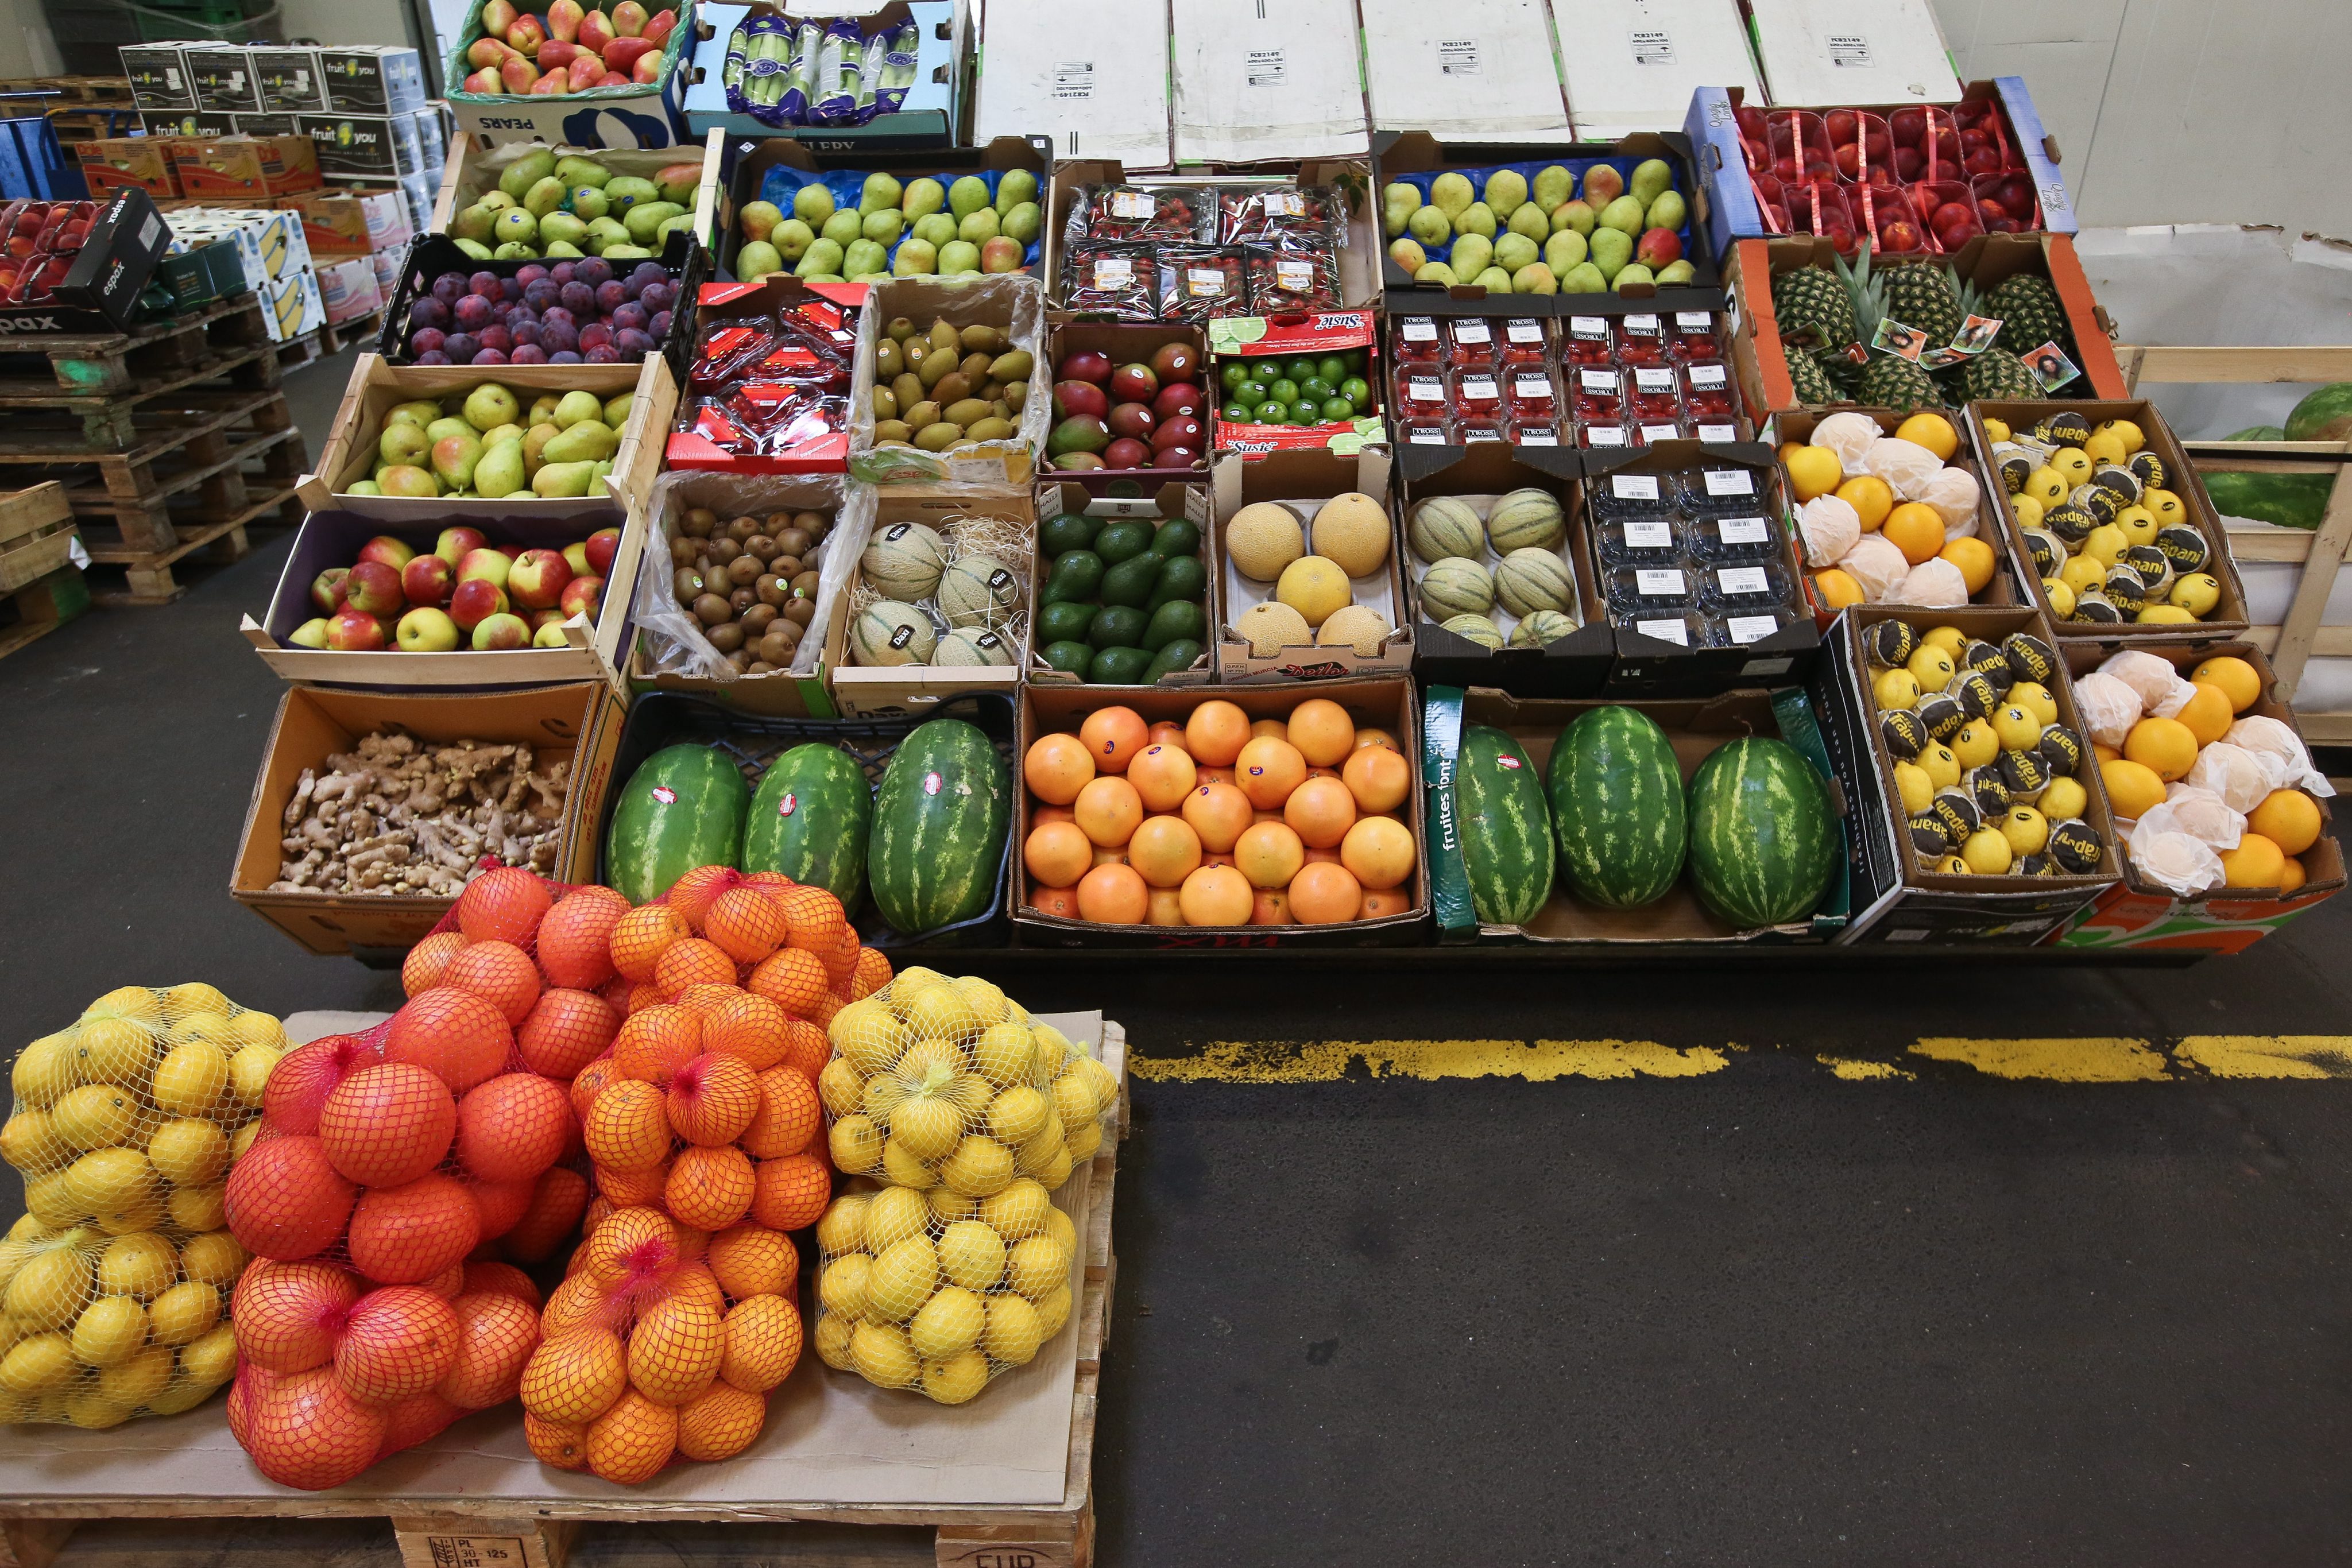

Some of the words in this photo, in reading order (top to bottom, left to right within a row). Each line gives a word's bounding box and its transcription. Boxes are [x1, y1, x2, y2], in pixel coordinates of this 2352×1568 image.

[326, 61, 345, 73] fruit
[358, 65, 375, 76] you
[131, 74, 144, 82] fruit
[262, 77, 274, 85] fruit
[156, 122, 180, 137] fruit
[197, 127, 220, 137] you
[479, 117, 535, 130] PEARS
[311, 126, 336, 142] fruit
[353, 132, 376, 145] you
[78, 144, 102, 156] Dole
[107, 199, 126, 224] espax
[103, 261, 126, 296] espax
[1040, 492, 1058, 509] HALLS
[1186, 493, 1204, 509] HALLS
[1041, 504, 1059, 520] HALLS
[1186, 503, 1204, 519] HALLS
[889, 526, 906, 539] Daxi
[991, 572, 1007, 585] Daxi
[893, 629, 910, 645] Daxi
[980, 635, 996, 645] Daxi
[1227, 672, 1252, 683] ORIGEN
[1252, 666, 1278, 676] MURCIA
[1282, 662, 1350, 677] Deilor
[1831, 730, 1841, 754] can
[1438, 759, 1452, 790] font
[1839, 761, 1850, 789] you
[1438, 792, 1456, 851] fruites
[1847, 795, 1864, 874] freshness
[459, 1539, 474, 1548] PL
[462, 1549, 476, 1558] 30
[486, 1550, 508, 1558] 125
[463, 1559, 480, 1567] HT
